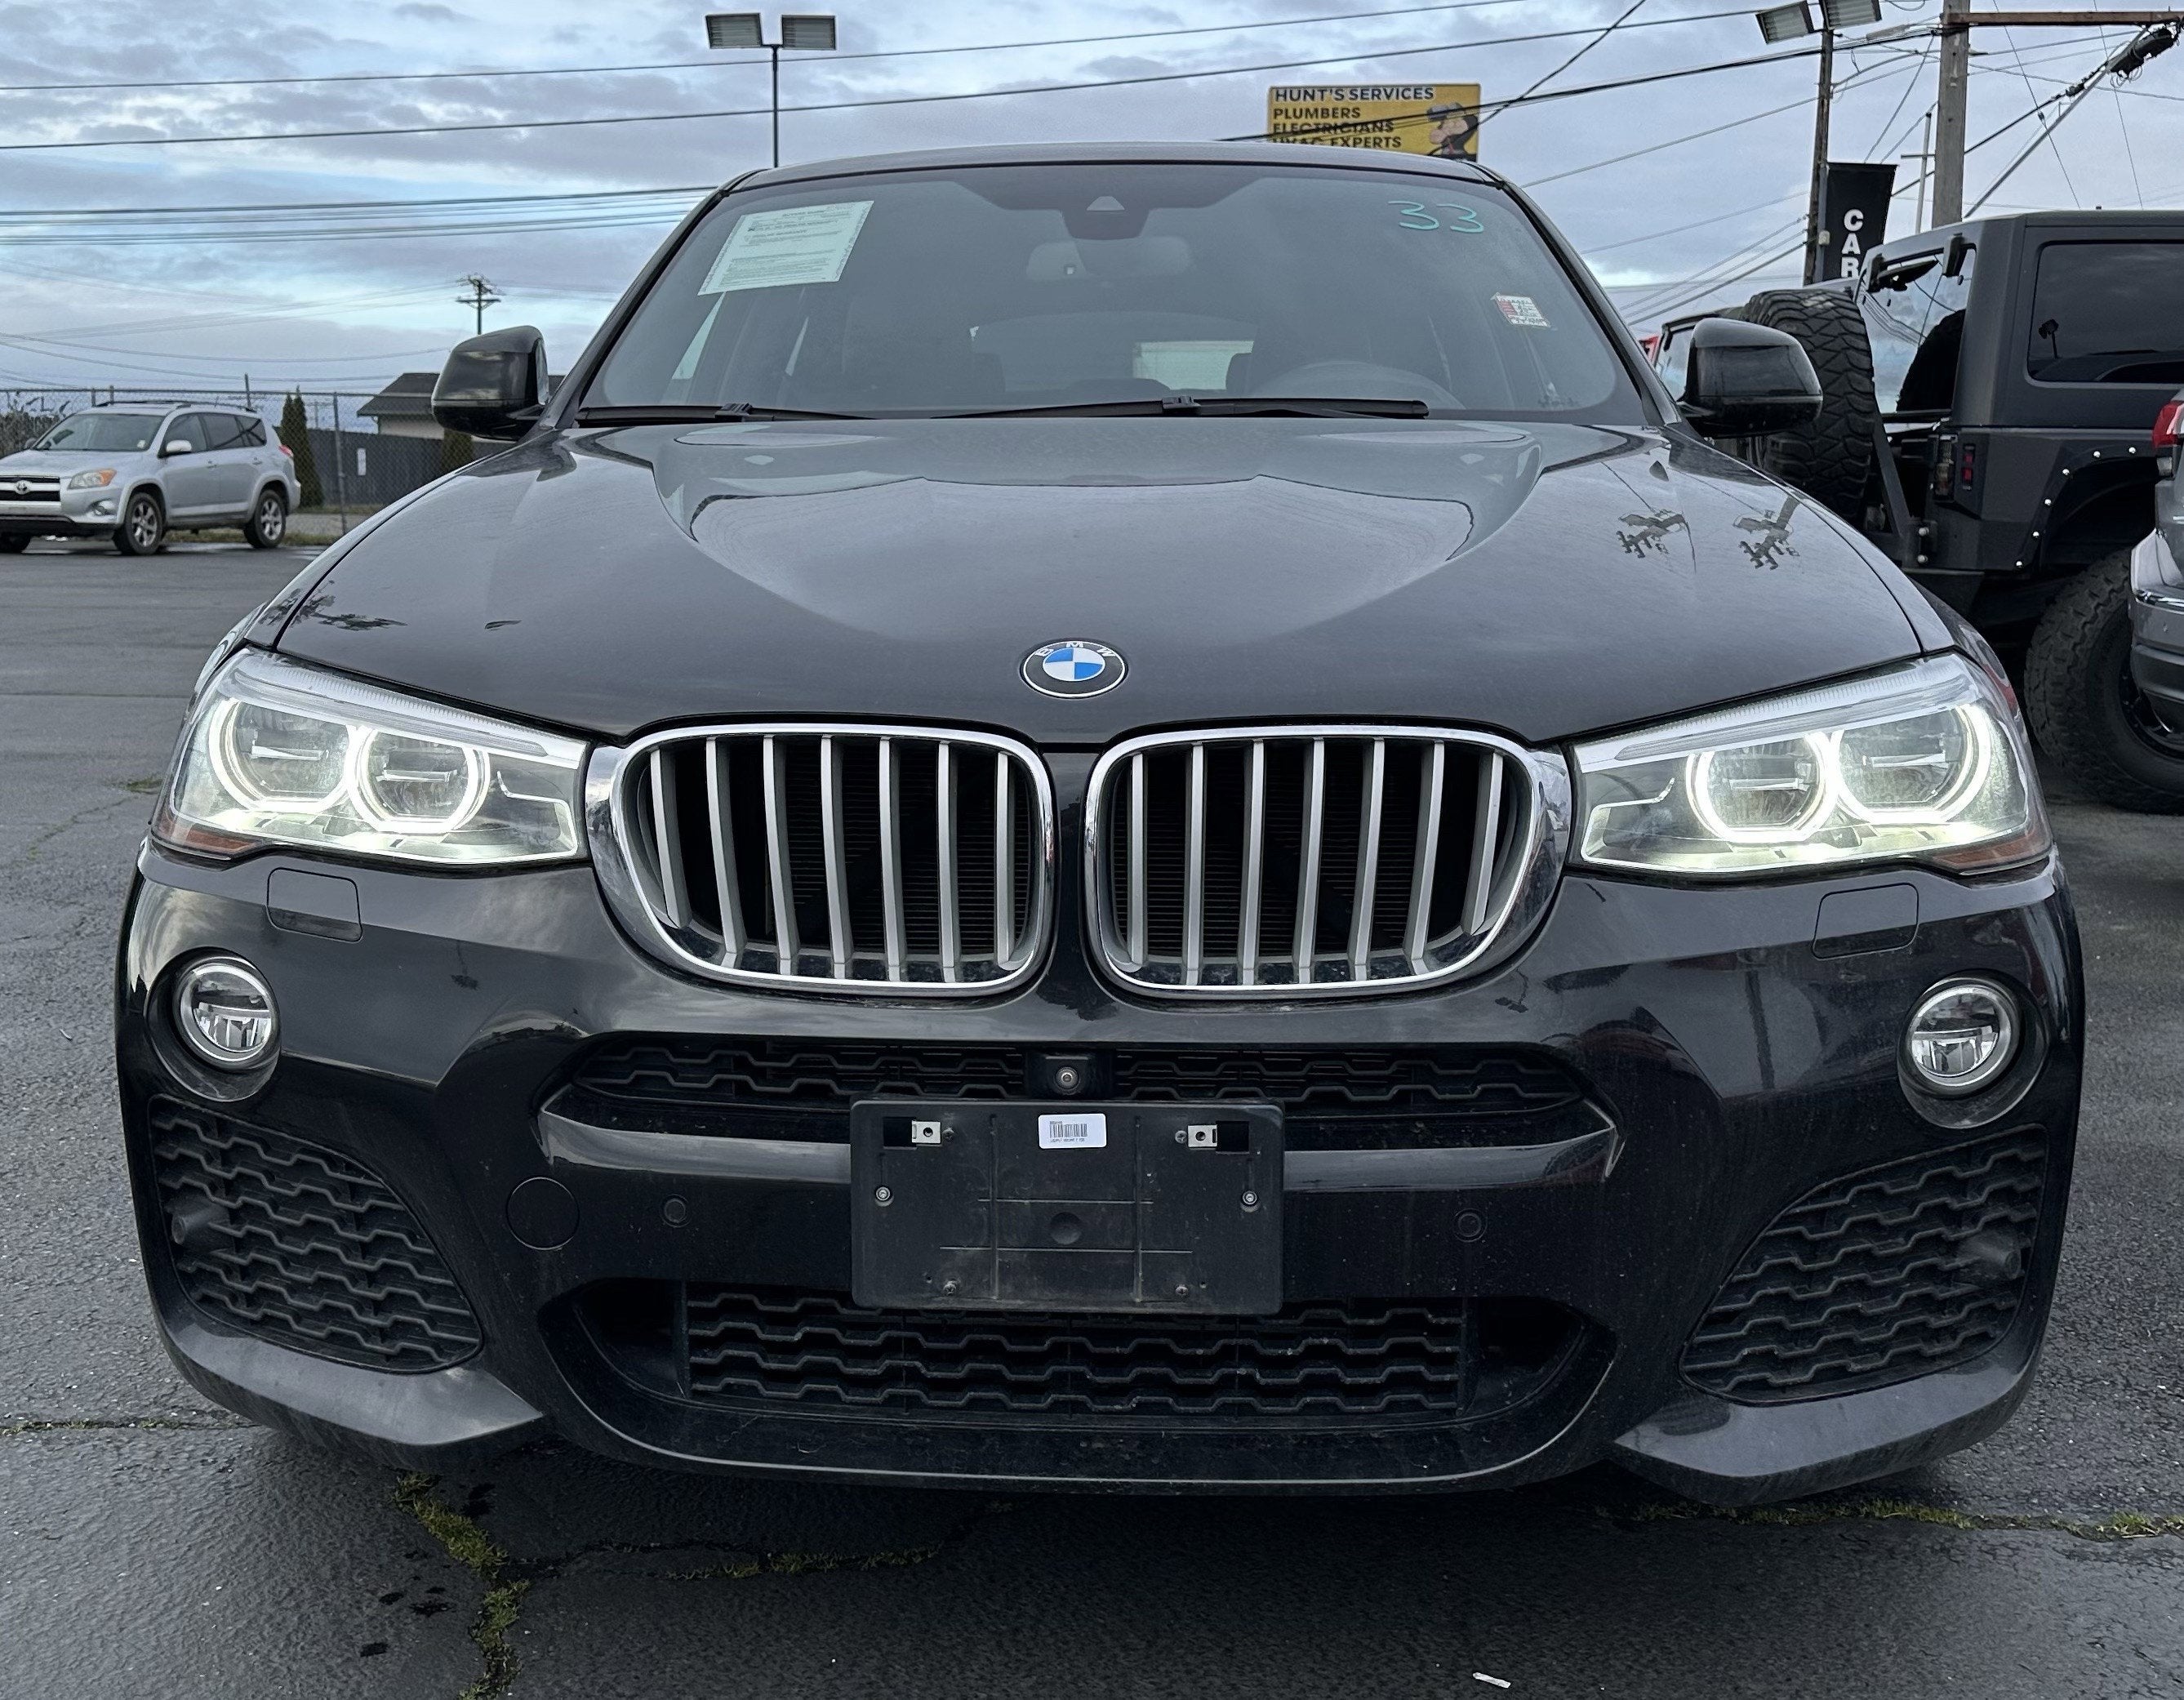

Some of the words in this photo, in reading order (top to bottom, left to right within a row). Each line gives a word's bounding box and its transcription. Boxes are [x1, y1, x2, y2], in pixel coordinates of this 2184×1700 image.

[1276, 89, 1345, 101] HUNT'S
[1349, 87, 1434, 100] SERVICES
[1274, 108, 1359, 119] PLUMBERS
[1330, 136, 1401, 148] EXPERTS
[1388, 200, 1484, 234] 33
[1840, 208, 1864, 278] CAR
[1034, 641, 1116, 656] BMW
